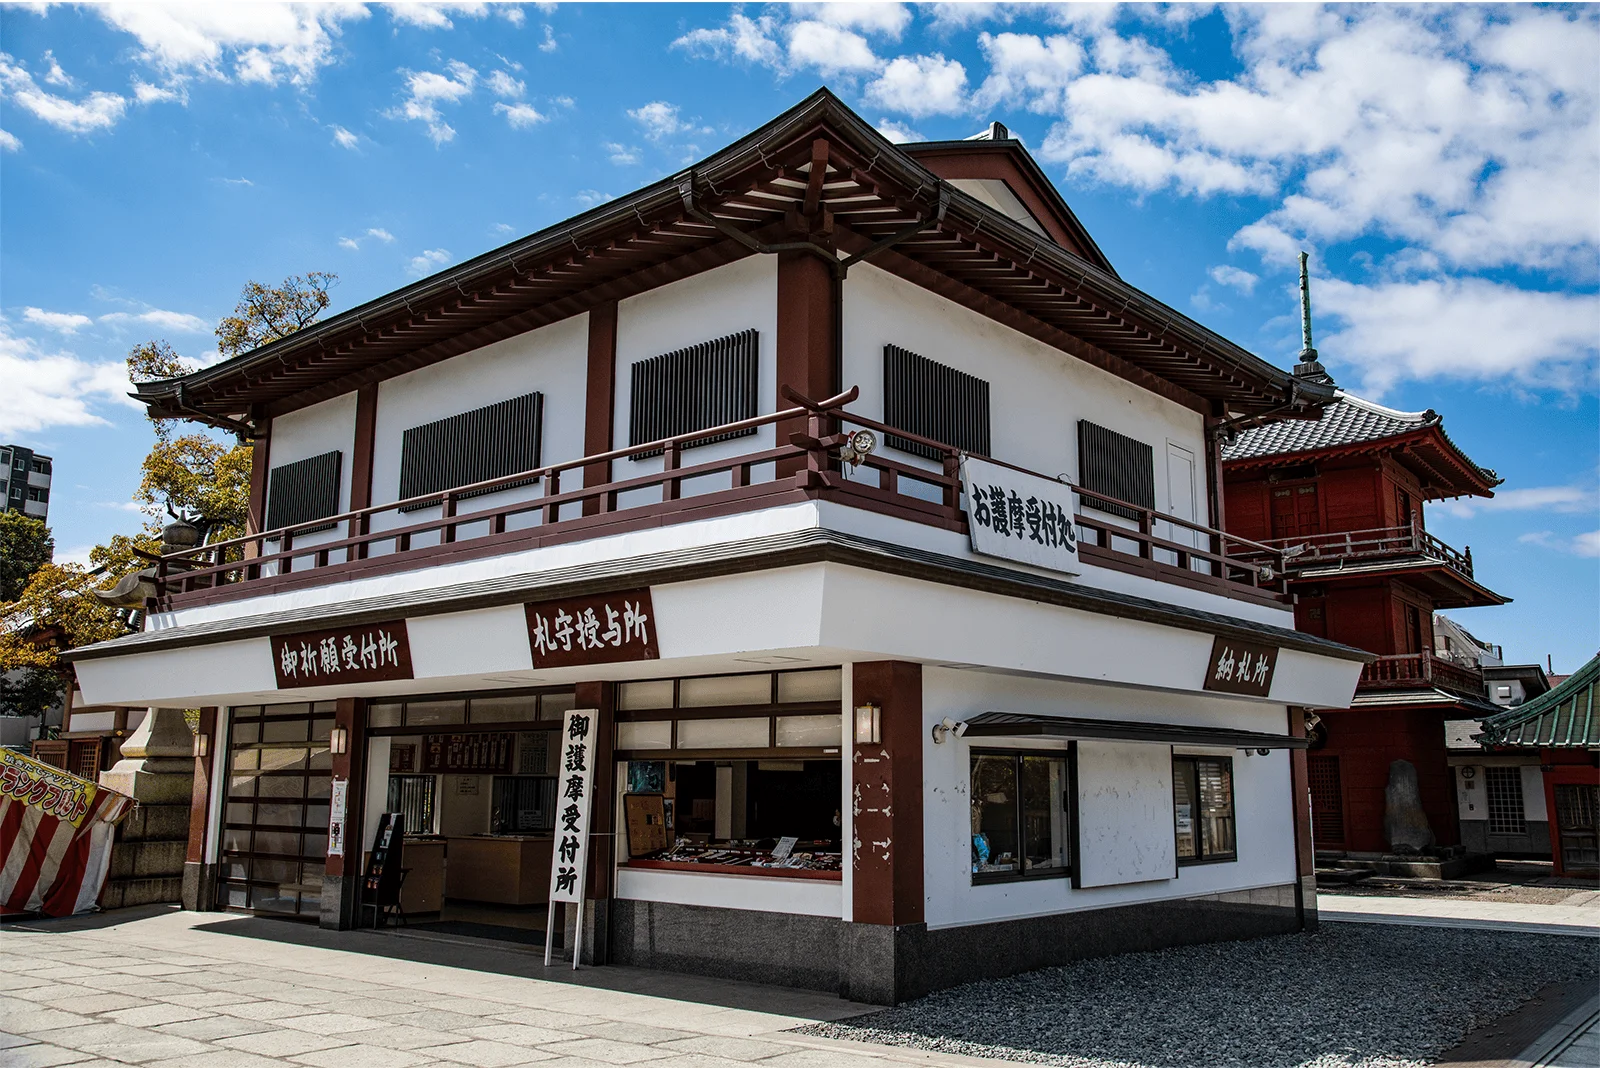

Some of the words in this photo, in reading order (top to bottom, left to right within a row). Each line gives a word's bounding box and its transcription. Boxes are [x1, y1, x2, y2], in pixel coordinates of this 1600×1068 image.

[972, 483, 1076, 553] お護摩受付処
[281, 629, 398, 679] 御祈願受付所
[533, 600, 648, 656] 札守授与所
[1215, 646, 1269, 687] 納札所
[555, 714, 590, 896] 御護摩受付所
